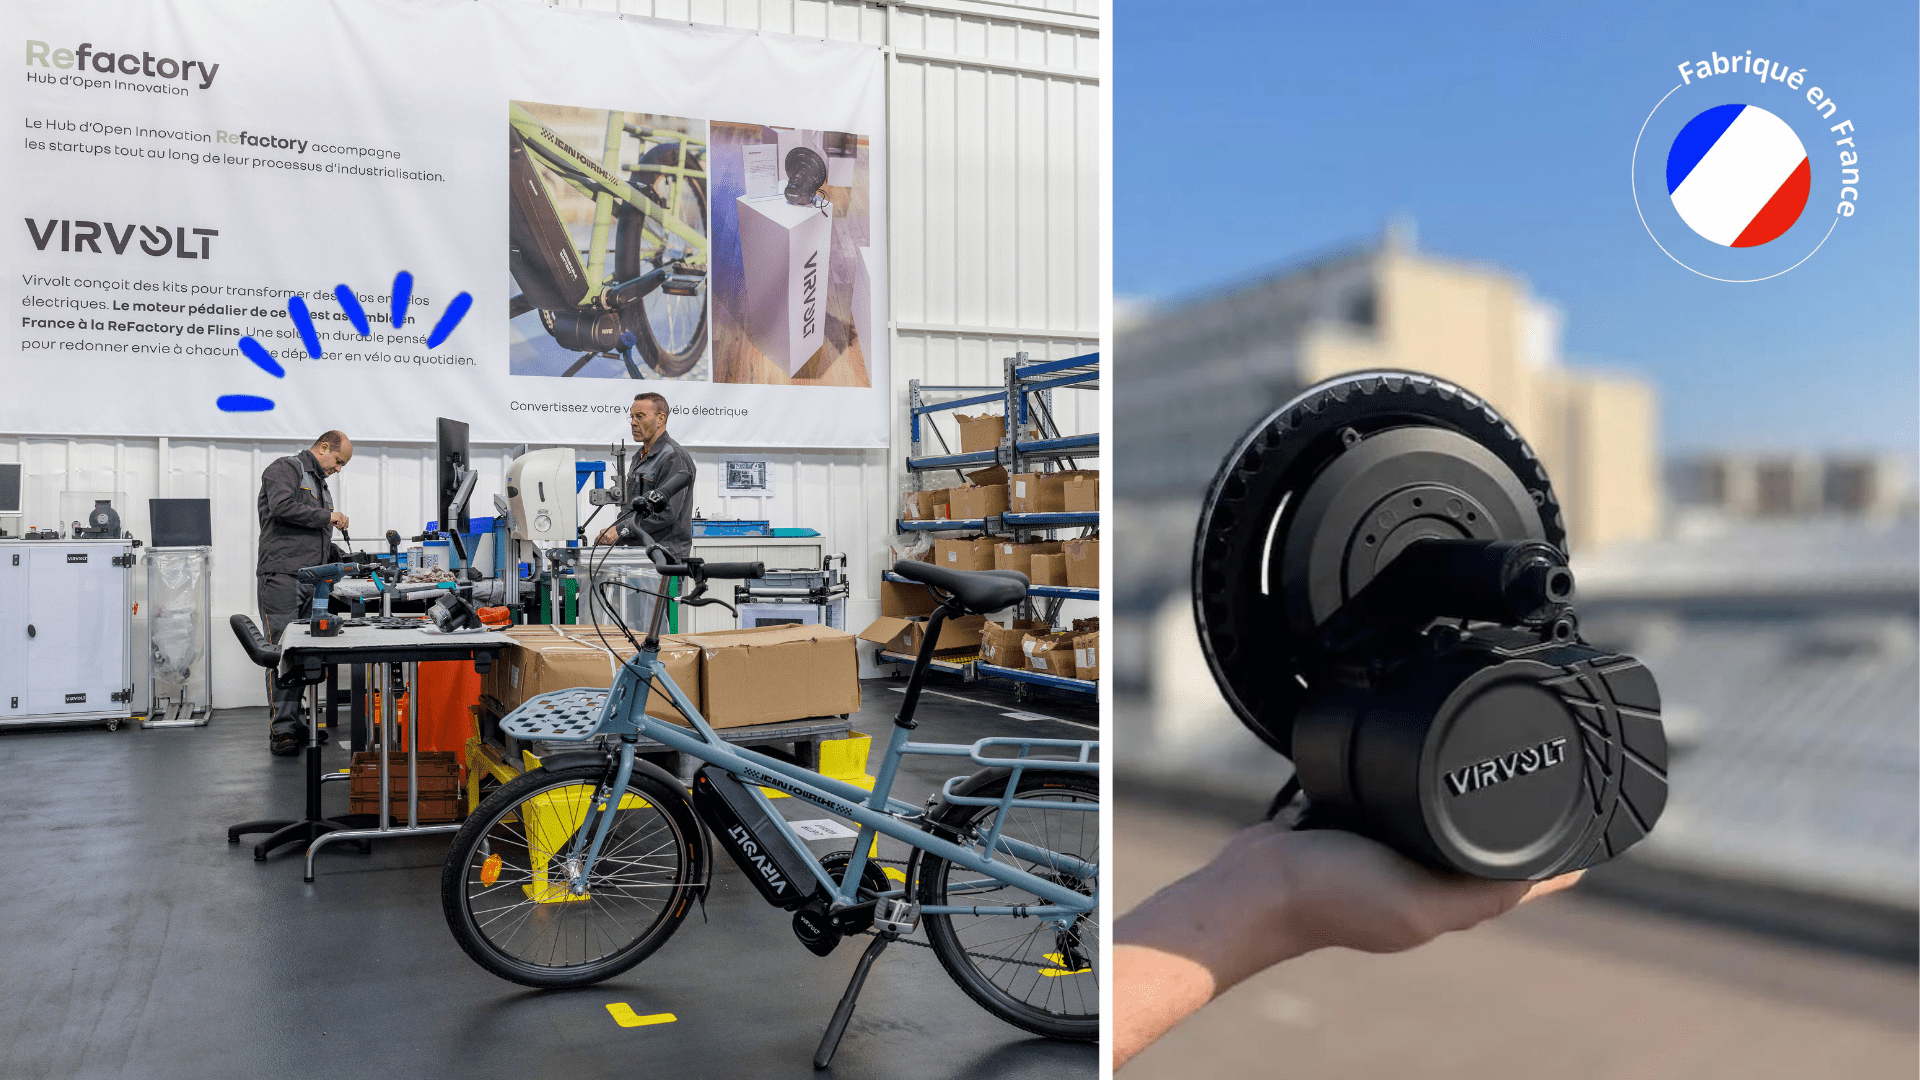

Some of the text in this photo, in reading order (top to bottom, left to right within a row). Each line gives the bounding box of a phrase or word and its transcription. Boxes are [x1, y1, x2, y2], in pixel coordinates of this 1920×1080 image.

[25, 39, 220, 89] Refactory
[27, 72, 189, 96] Hub d'Open Innovation
[25, 117, 401, 160] Le Hub d'Open Innovation Refactory accompagne
[25, 138, 46, 150] les
[49, 140, 111, 156] startups
[114, 144, 144, 158] tout
[147, 149, 165, 159] au
[168, 148, 199, 164] long
[202, 152, 220, 164] de
[223, 153, 250, 166] leur
[252, 156, 322, 172] processus
[24, 217, 219, 260] VIRVOLT
[22, 274, 71, 287] Virvolt
[74, 277, 130, 292] conçoit
[133, 279, 159, 292] des
[162, 280, 188, 293] kits
[191, 283, 223, 296] pour
[226, 285, 310, 300] transformer
[313, 289, 337, 301] des
[377, 294, 393, 304] en
[803, 250, 818, 339] VIRVOLT
[22, 295, 110, 311] électriques.
[112, 300, 130, 311] Le
[133, 301, 185, 313] moteur
[188, 303, 248, 317] pédalier
[250, 306, 268, 317] de
[270, 308, 287, 318] ce
[310, 310, 330, 321] est
[333, 311, 397, 323] asmbl
[22, 317, 75, 330] France
[78, 318, 88, 330] à
[91, 318, 104, 331] la
[108, 320, 184, 337] ReFactory
[187, 323, 204, 335] de
[207, 324, 243, 337] Flins.
[246, 326, 273, 338] Une
[333, 331, 384, 343] durable
[22, 339, 56, 352] pour
[59, 339, 129, 352] redonner
[131, 342, 171, 354] envie
[174, 343, 183, 355] à
[185, 344, 239, 357] chacun
[281, 347, 343, 361] dépcer
[345, 353, 362, 362] en
[364, 351, 391, 363] vélo
[394, 354, 410, 364] au
[413, 354, 477, 366] quotidien.
[510, 400, 588, 413] Convertissez
[590, 403, 621, 414] votre
[692, 404, 749, 418] électrique
[1445, 737, 1567, 796] VIRVOLT
[727, 825, 787, 895] VIRVOLT
